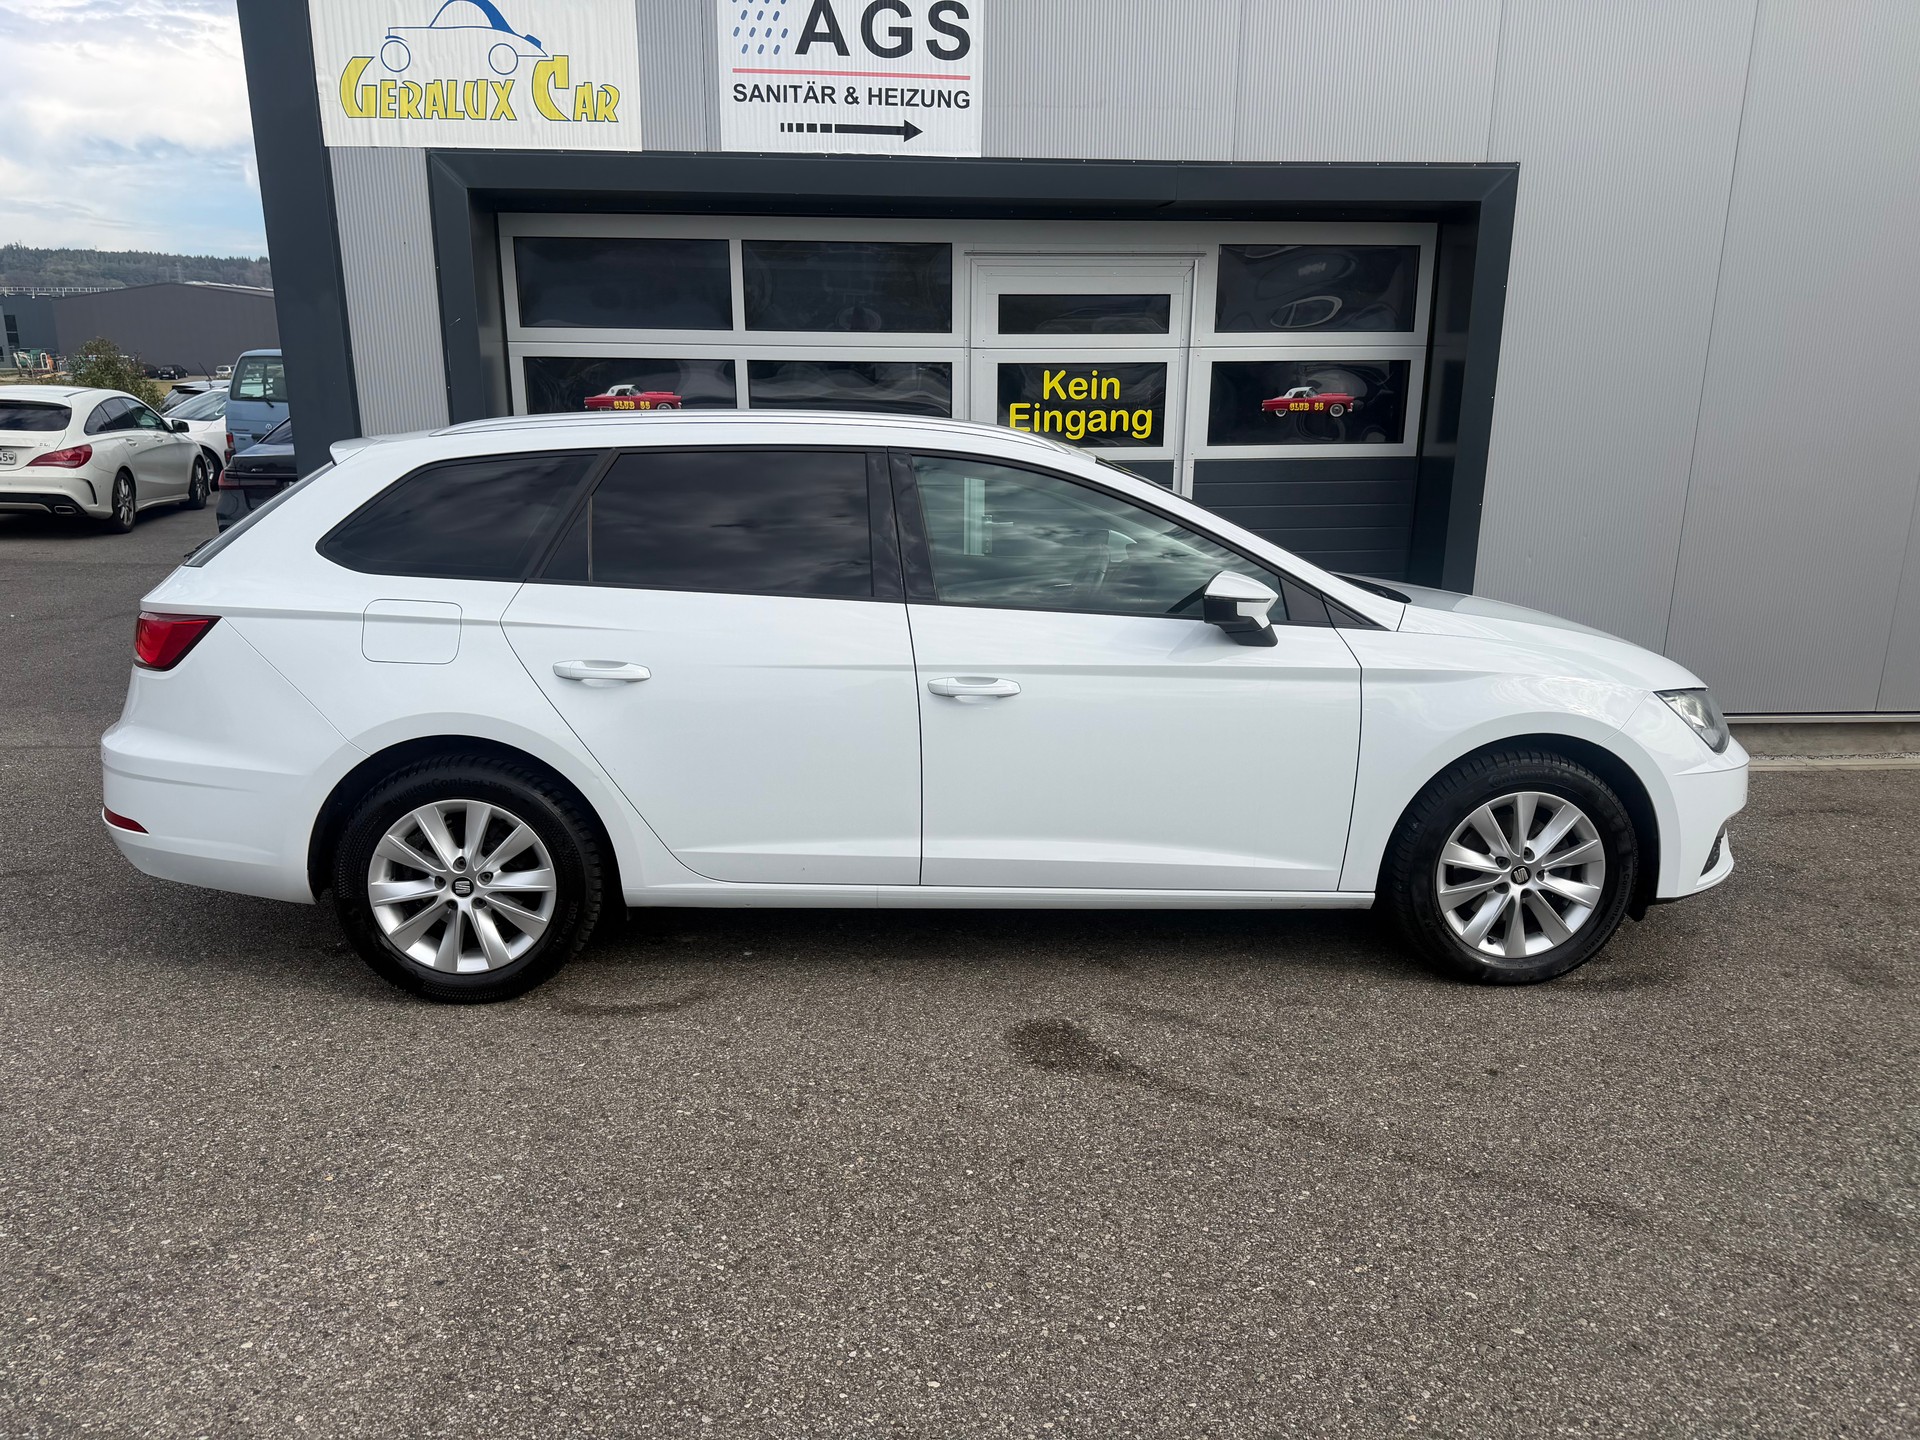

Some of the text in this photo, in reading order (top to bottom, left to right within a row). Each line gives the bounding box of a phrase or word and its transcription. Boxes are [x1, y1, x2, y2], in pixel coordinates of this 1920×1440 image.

[794, 0, 971, 61] AGS
[733, 81, 971, 109] SANITÄR & HEIZUNG
[1043, 370, 1121, 400] Kein
[1009, 403, 1153, 440] Eingang
[1289, 402, 1310, 411] CLUB
